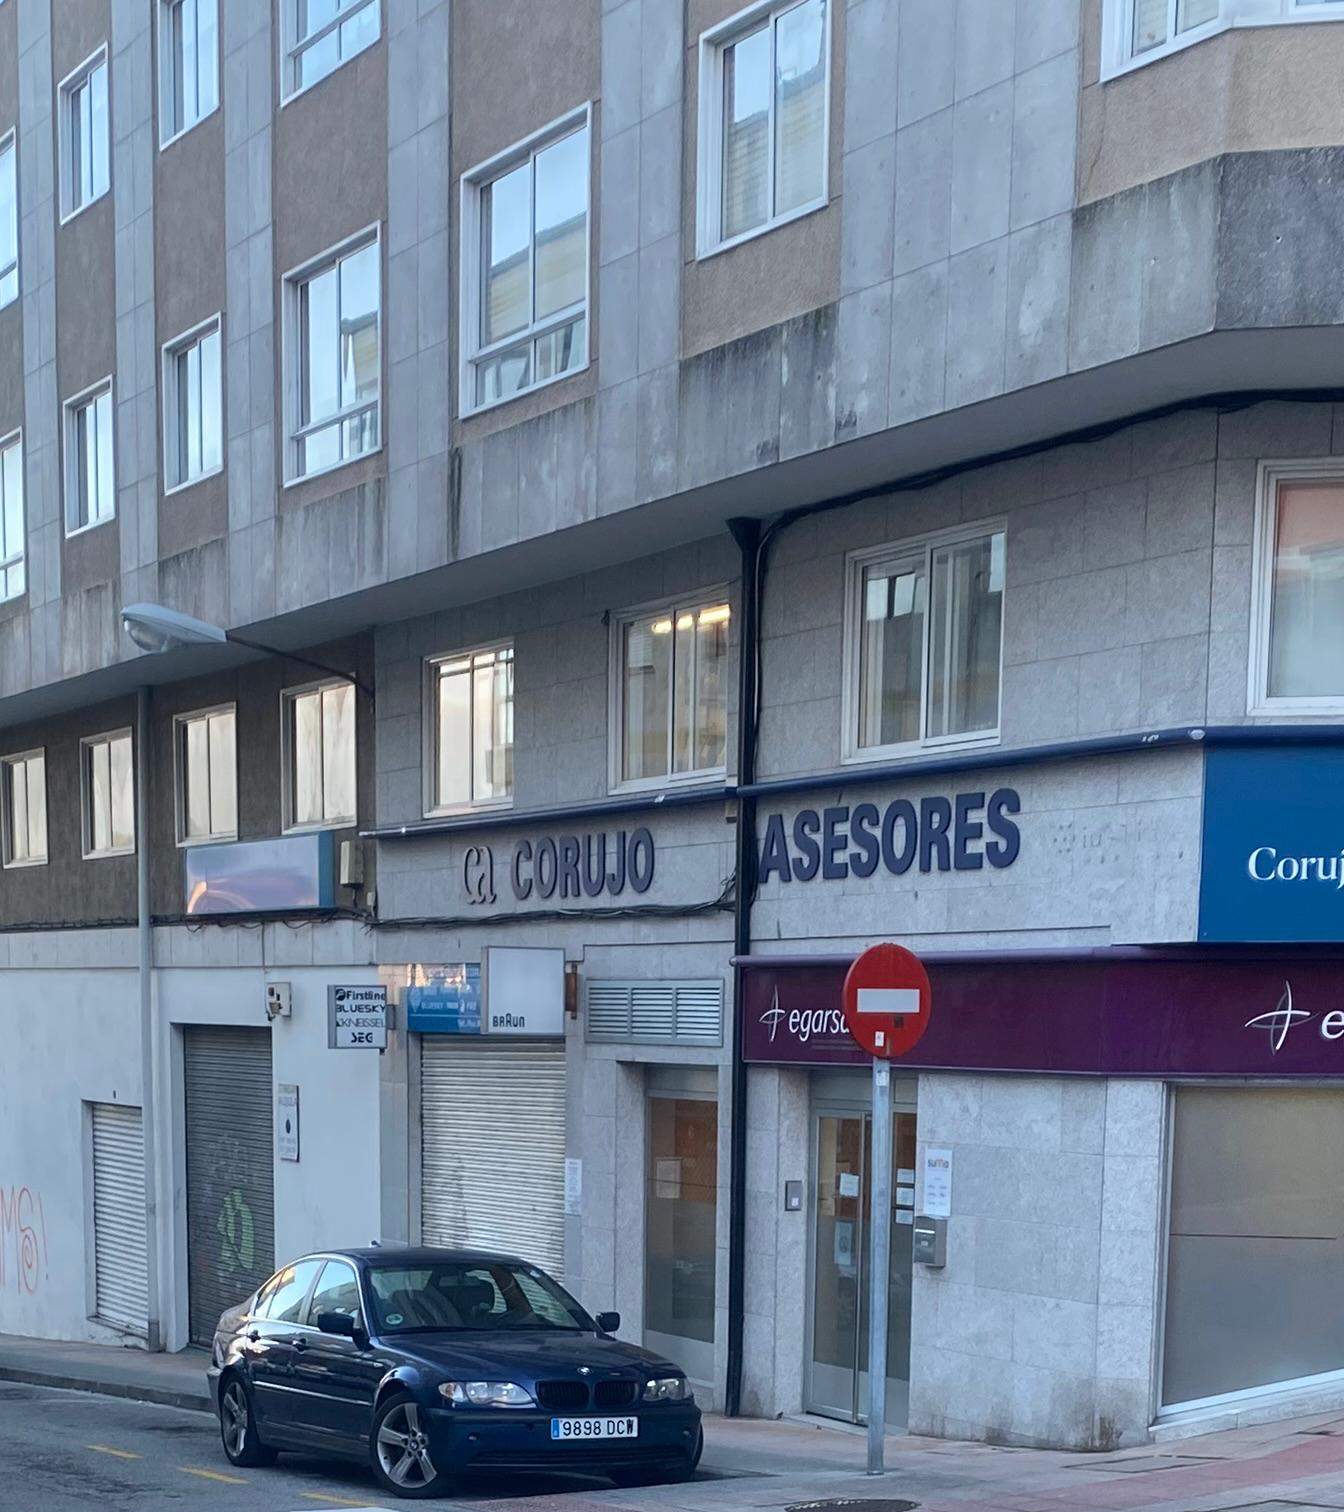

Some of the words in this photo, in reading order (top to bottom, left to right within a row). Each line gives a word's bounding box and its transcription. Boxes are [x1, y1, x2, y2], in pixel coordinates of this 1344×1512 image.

[511, 827, 655, 900] CORUJO
[759, 787, 1021, 884] ASESORES
[335, 1004, 386, 1013] BLUESKY
[562, 1420, 602, 1437] 9898
